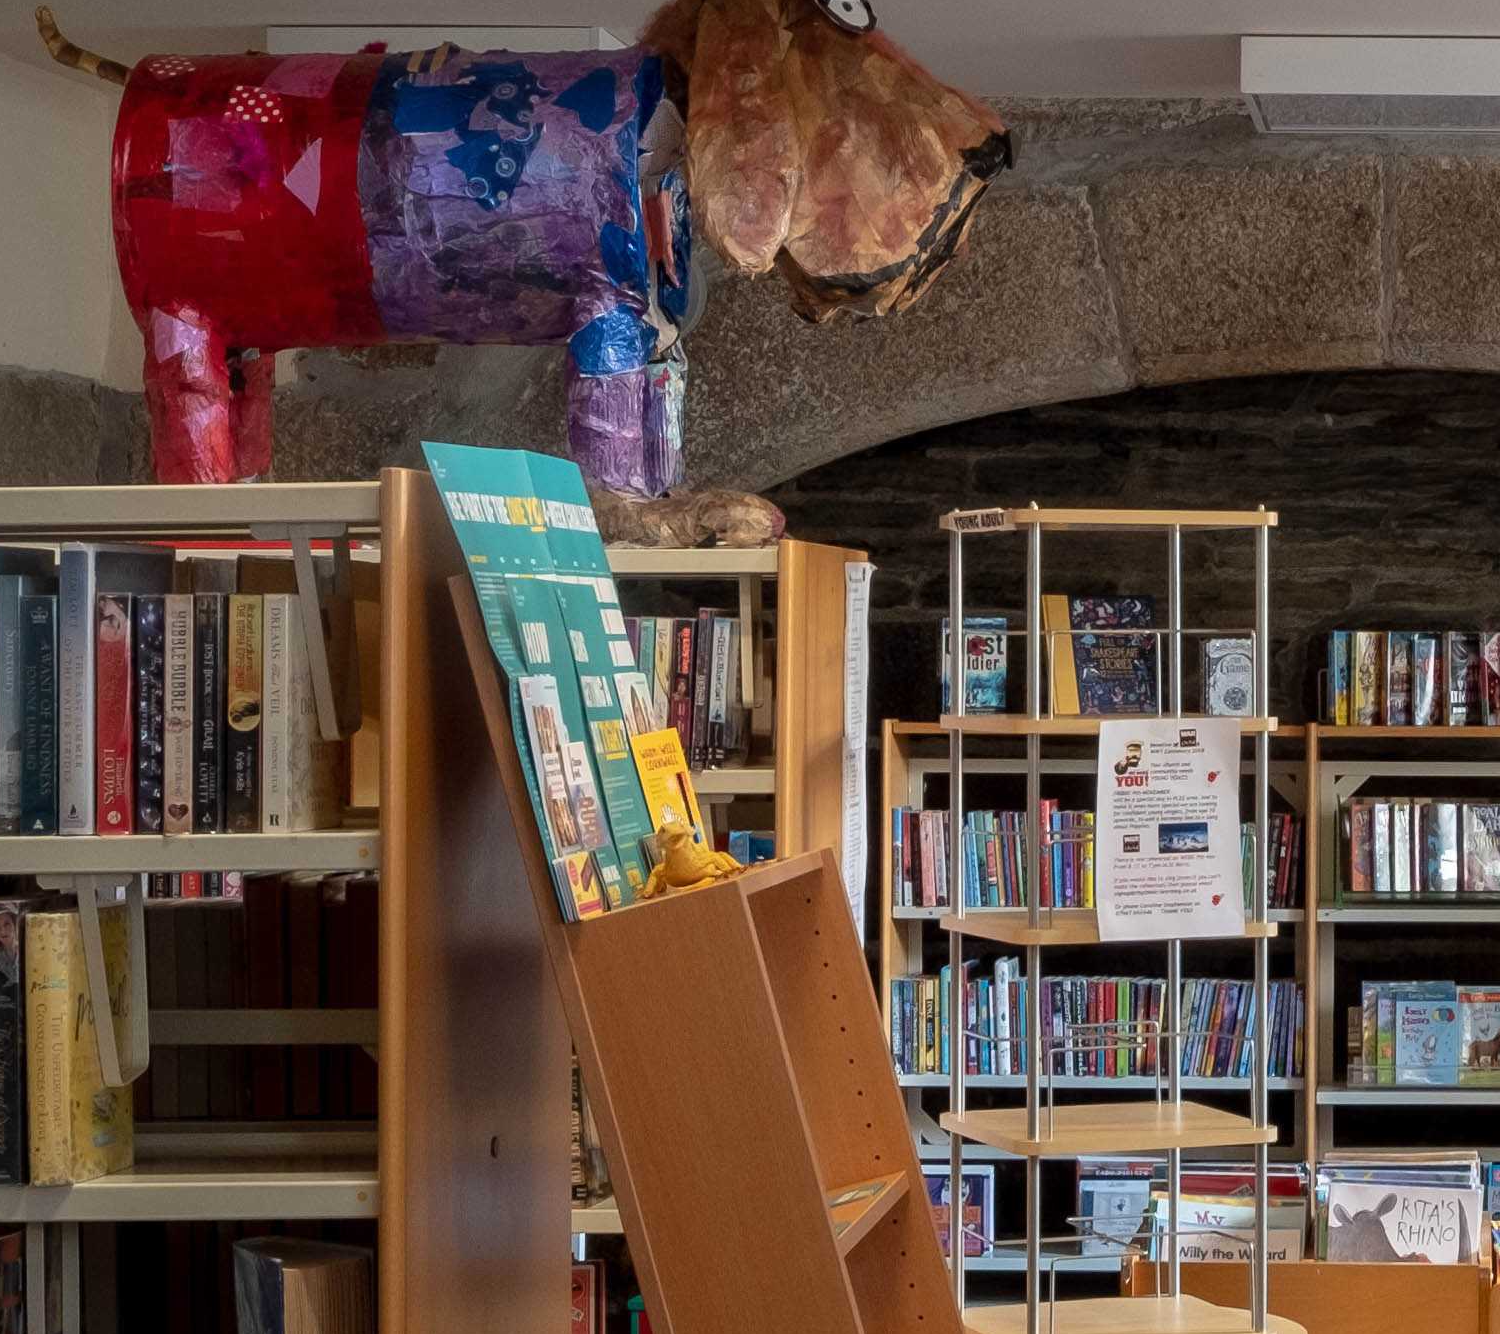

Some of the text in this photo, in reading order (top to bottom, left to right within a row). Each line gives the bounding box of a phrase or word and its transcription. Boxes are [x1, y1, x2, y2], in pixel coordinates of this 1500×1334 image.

[102, 747, 116, 805] LOUPAS
[1114, 774, 1150, 788] YOU!
[1398, 1196, 1458, 1223] RITA'S
[1396, 1224, 1456, 1246] RHINO
